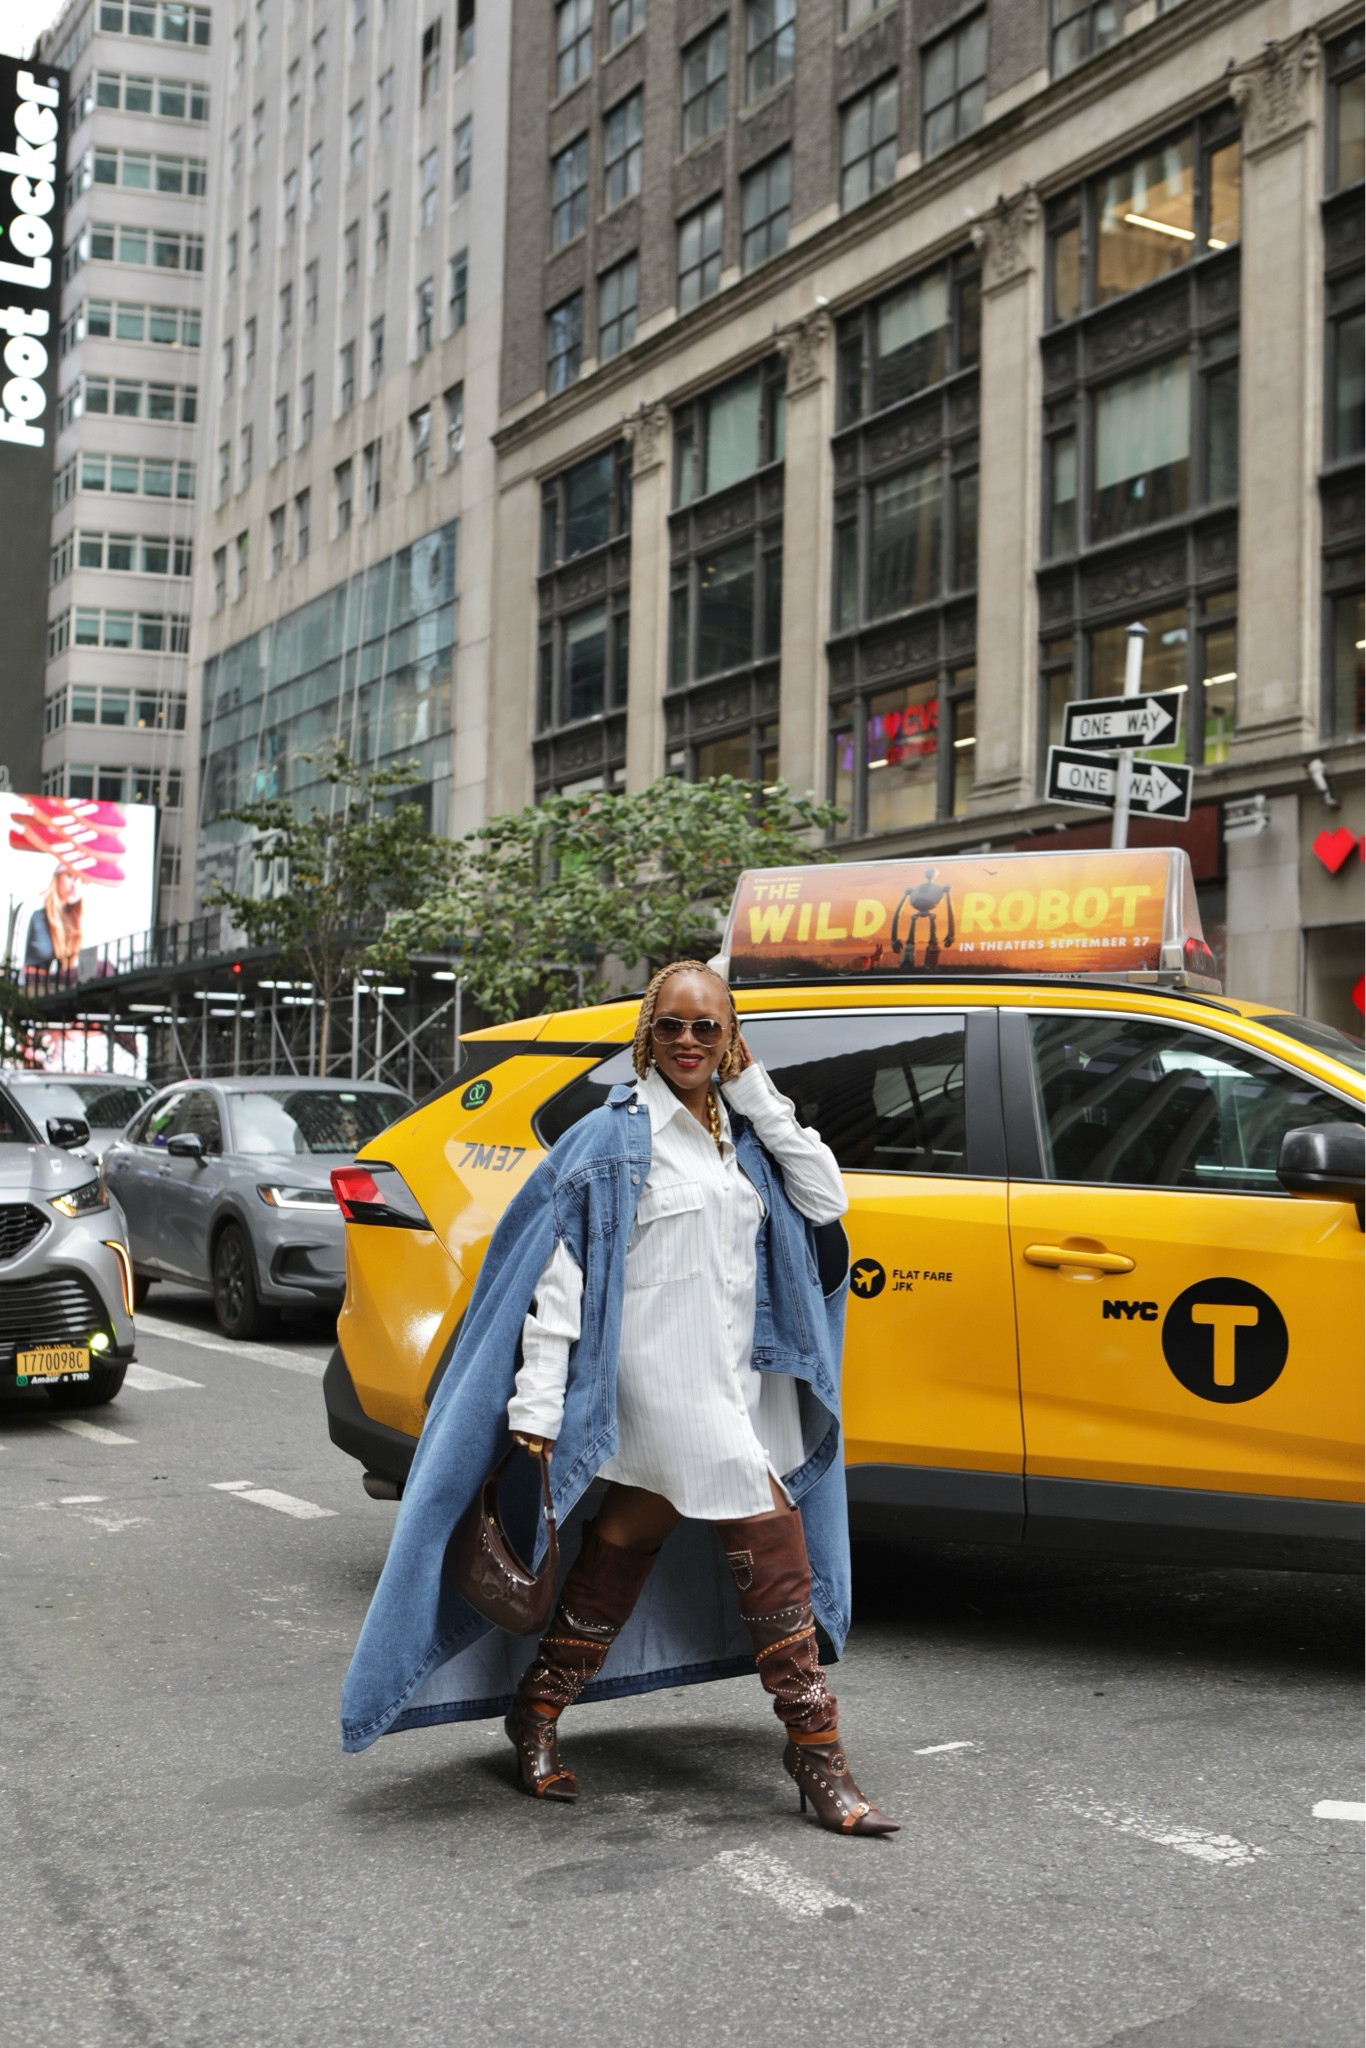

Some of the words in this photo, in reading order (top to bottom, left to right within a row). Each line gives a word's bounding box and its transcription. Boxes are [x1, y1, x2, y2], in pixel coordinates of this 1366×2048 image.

[0, 70, 60, 290] Locker
[0, 306, 49, 448] Foot
[1080, 715, 1112, 737] ONE
[1127, 711, 1161, 733] WAY
[1069, 768, 1109, 792] ONE
[1129, 777, 1168, 800] WAY
[753, 882, 801, 901] THE
[748, 899, 887, 944] WILD
[960, 885, 1151, 934] ROBOT
[959, 942, 975, 952] IN
[980, 939, 1045, 951] THEATERS
[1050, 936, 1127, 949] SEPTEMBER
[1133, 936, 1150, 947] 27
[457, 1142, 527, 1173] 7M37
[892, 1269, 920, 1280] FLAT
[923, 1271, 953, 1282] FARE
[892, 1281, 914, 1292] JFK
[1102, 1300, 1159, 1321] NYC
[1191, 1303, 1259, 1386] T
[22, 1350, 83, 1373] T770098C
